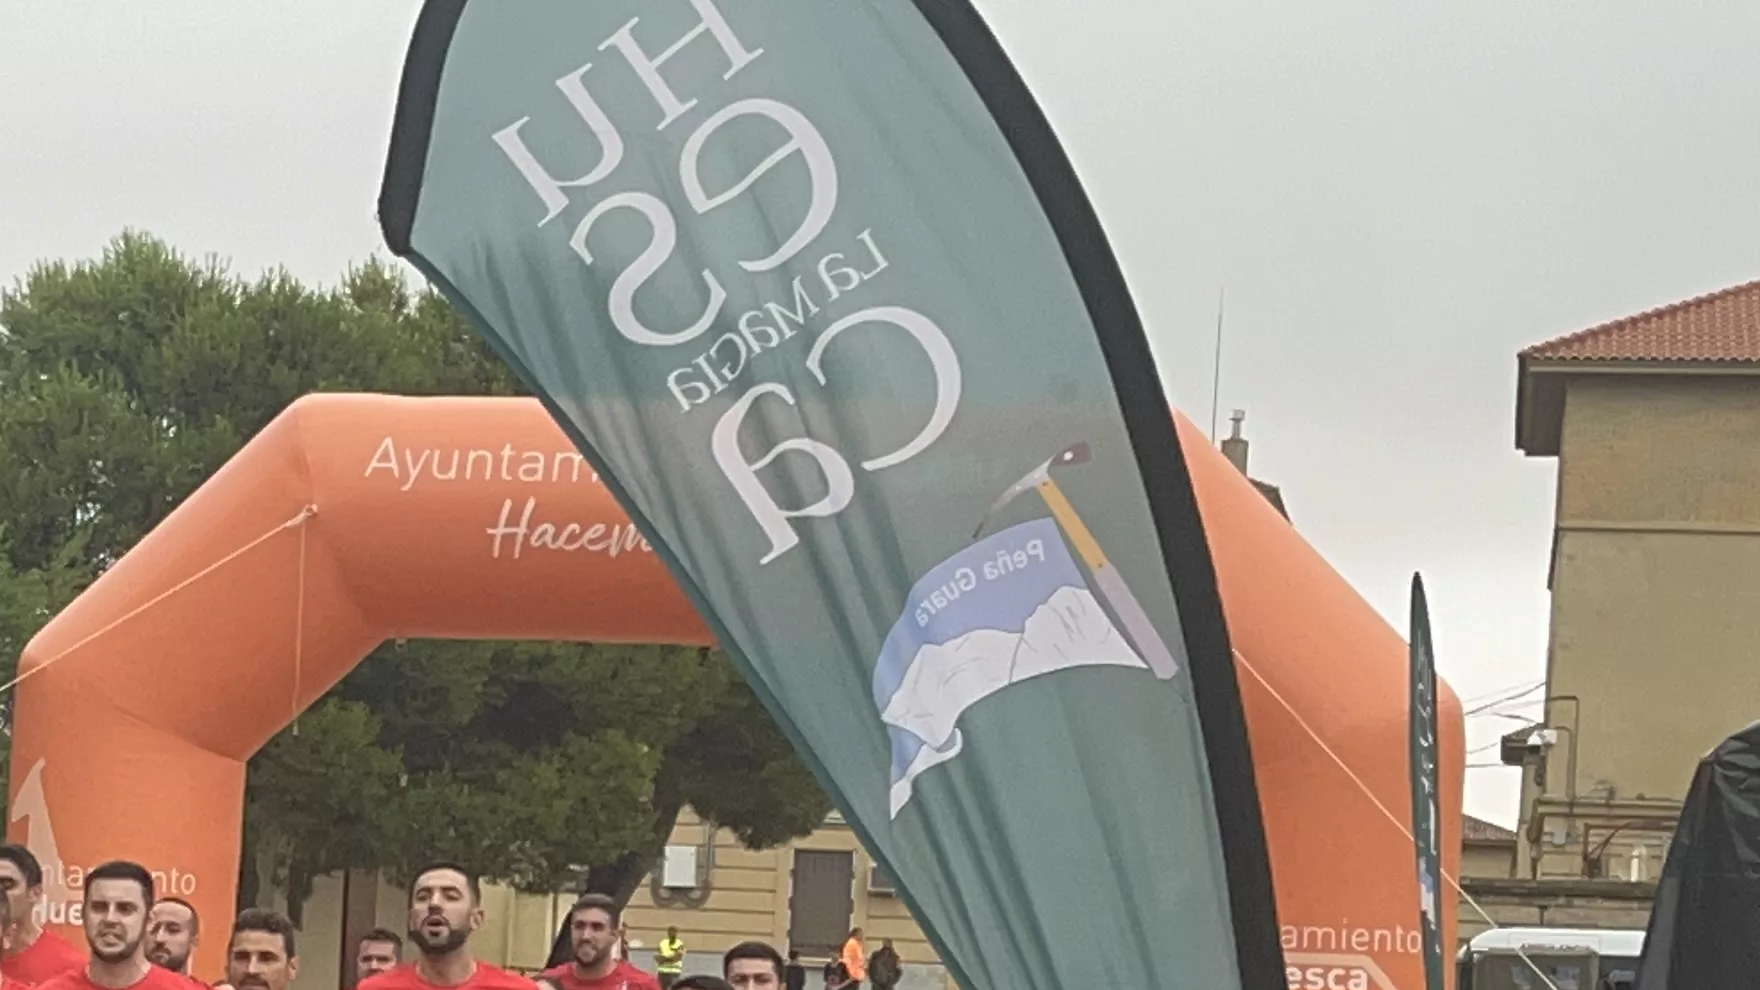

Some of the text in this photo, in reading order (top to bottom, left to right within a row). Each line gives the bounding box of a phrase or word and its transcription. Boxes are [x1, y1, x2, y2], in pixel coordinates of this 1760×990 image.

[363, 436, 599, 491] Ayuntam
[485, 496, 653, 559] Hacem
[1280, 917, 1422, 954] amiento
